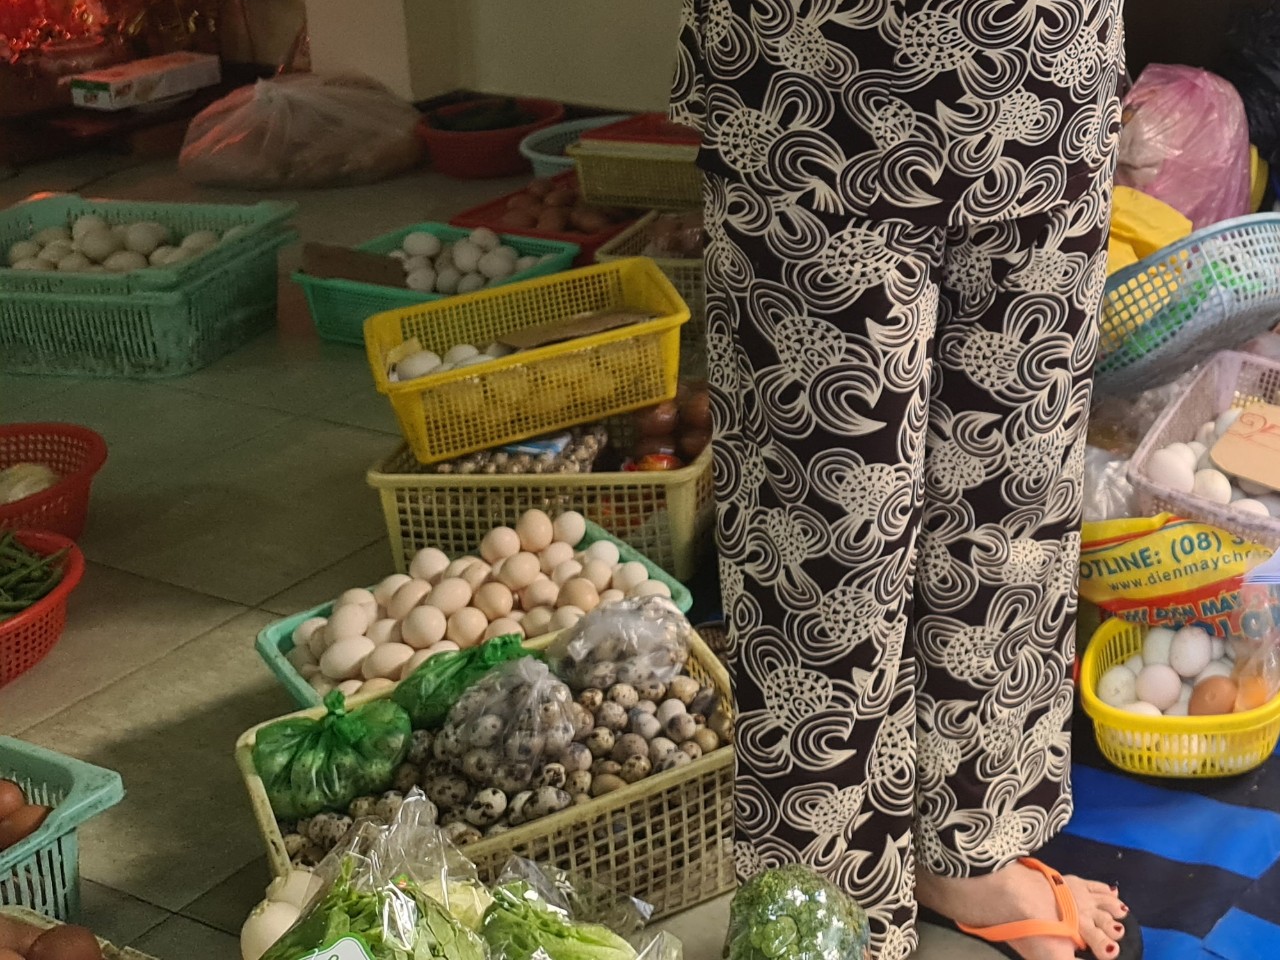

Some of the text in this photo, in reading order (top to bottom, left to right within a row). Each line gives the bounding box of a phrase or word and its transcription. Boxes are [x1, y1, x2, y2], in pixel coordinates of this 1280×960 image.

[1079, 530, 1222, 579] OTLINE: (08)
[1108, 548, 1273, 593] www.dienmaych
